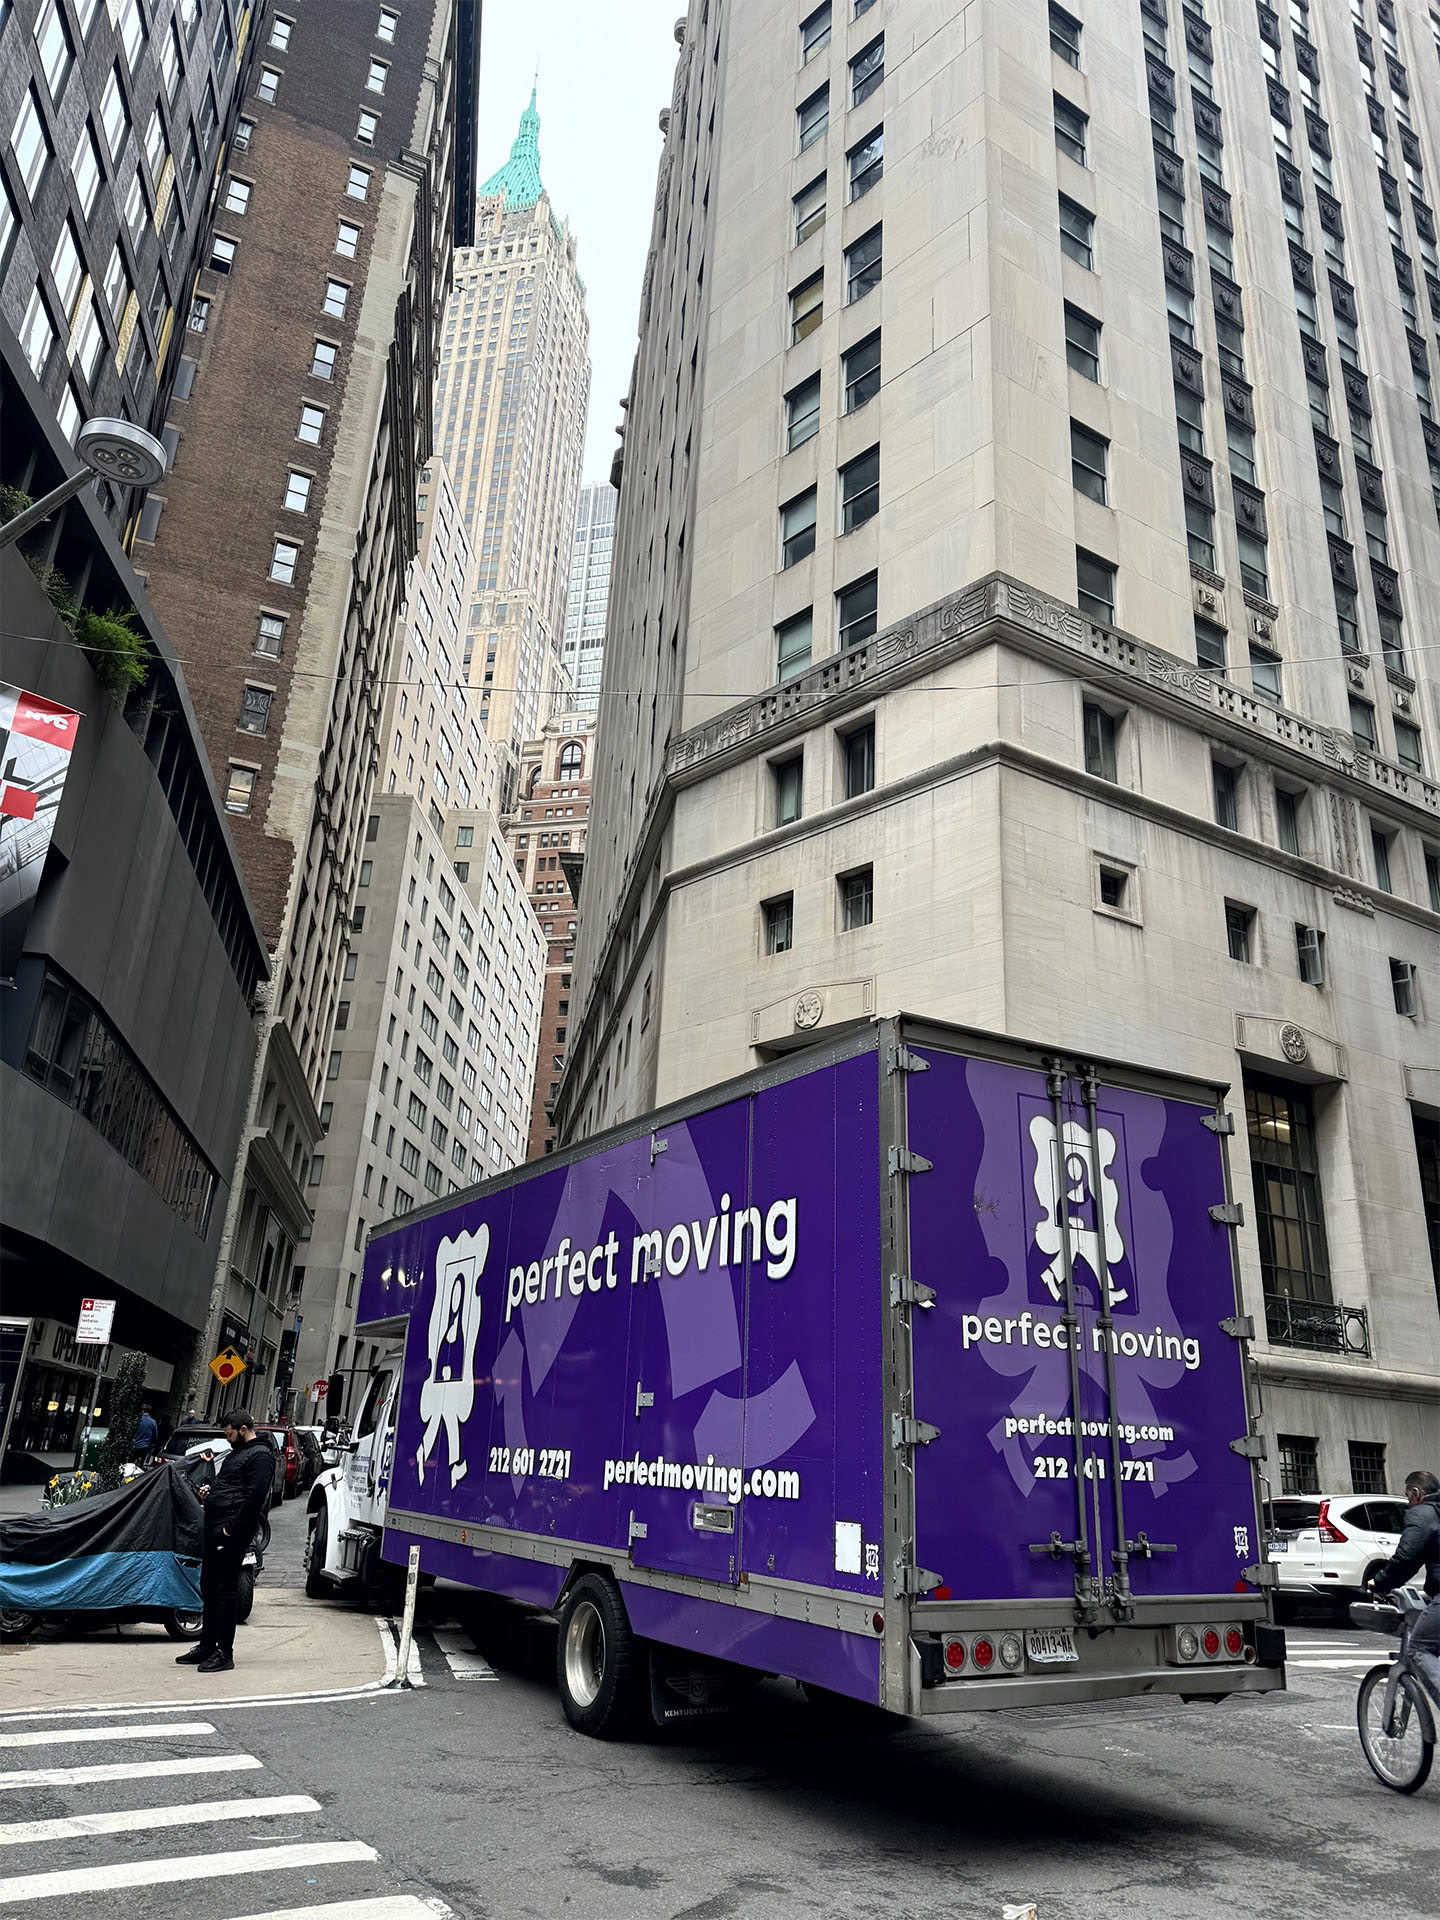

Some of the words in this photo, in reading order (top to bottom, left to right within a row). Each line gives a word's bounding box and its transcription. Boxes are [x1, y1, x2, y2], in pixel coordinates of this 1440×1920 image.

[25, 710, 69, 730] NYC
[505, 1231, 620, 1323] perfect
[630, 1193, 797, 1280] moving
[52, 1325, 79, 1364] OPEN
[488, 1447, 510, 1474] 212
[513, 1448, 535, 1476] 601
[538, 1449, 571, 1482] 2721
[1033, 1456, 1069, 1479] 212
[603, 1451, 800, 1504] perfectmoving.com
[1237, 1531, 1246, 1546] 12
[869, 1550, 877, 1566] 12
[664, 1707, 703, 1718] KENTUCKY
